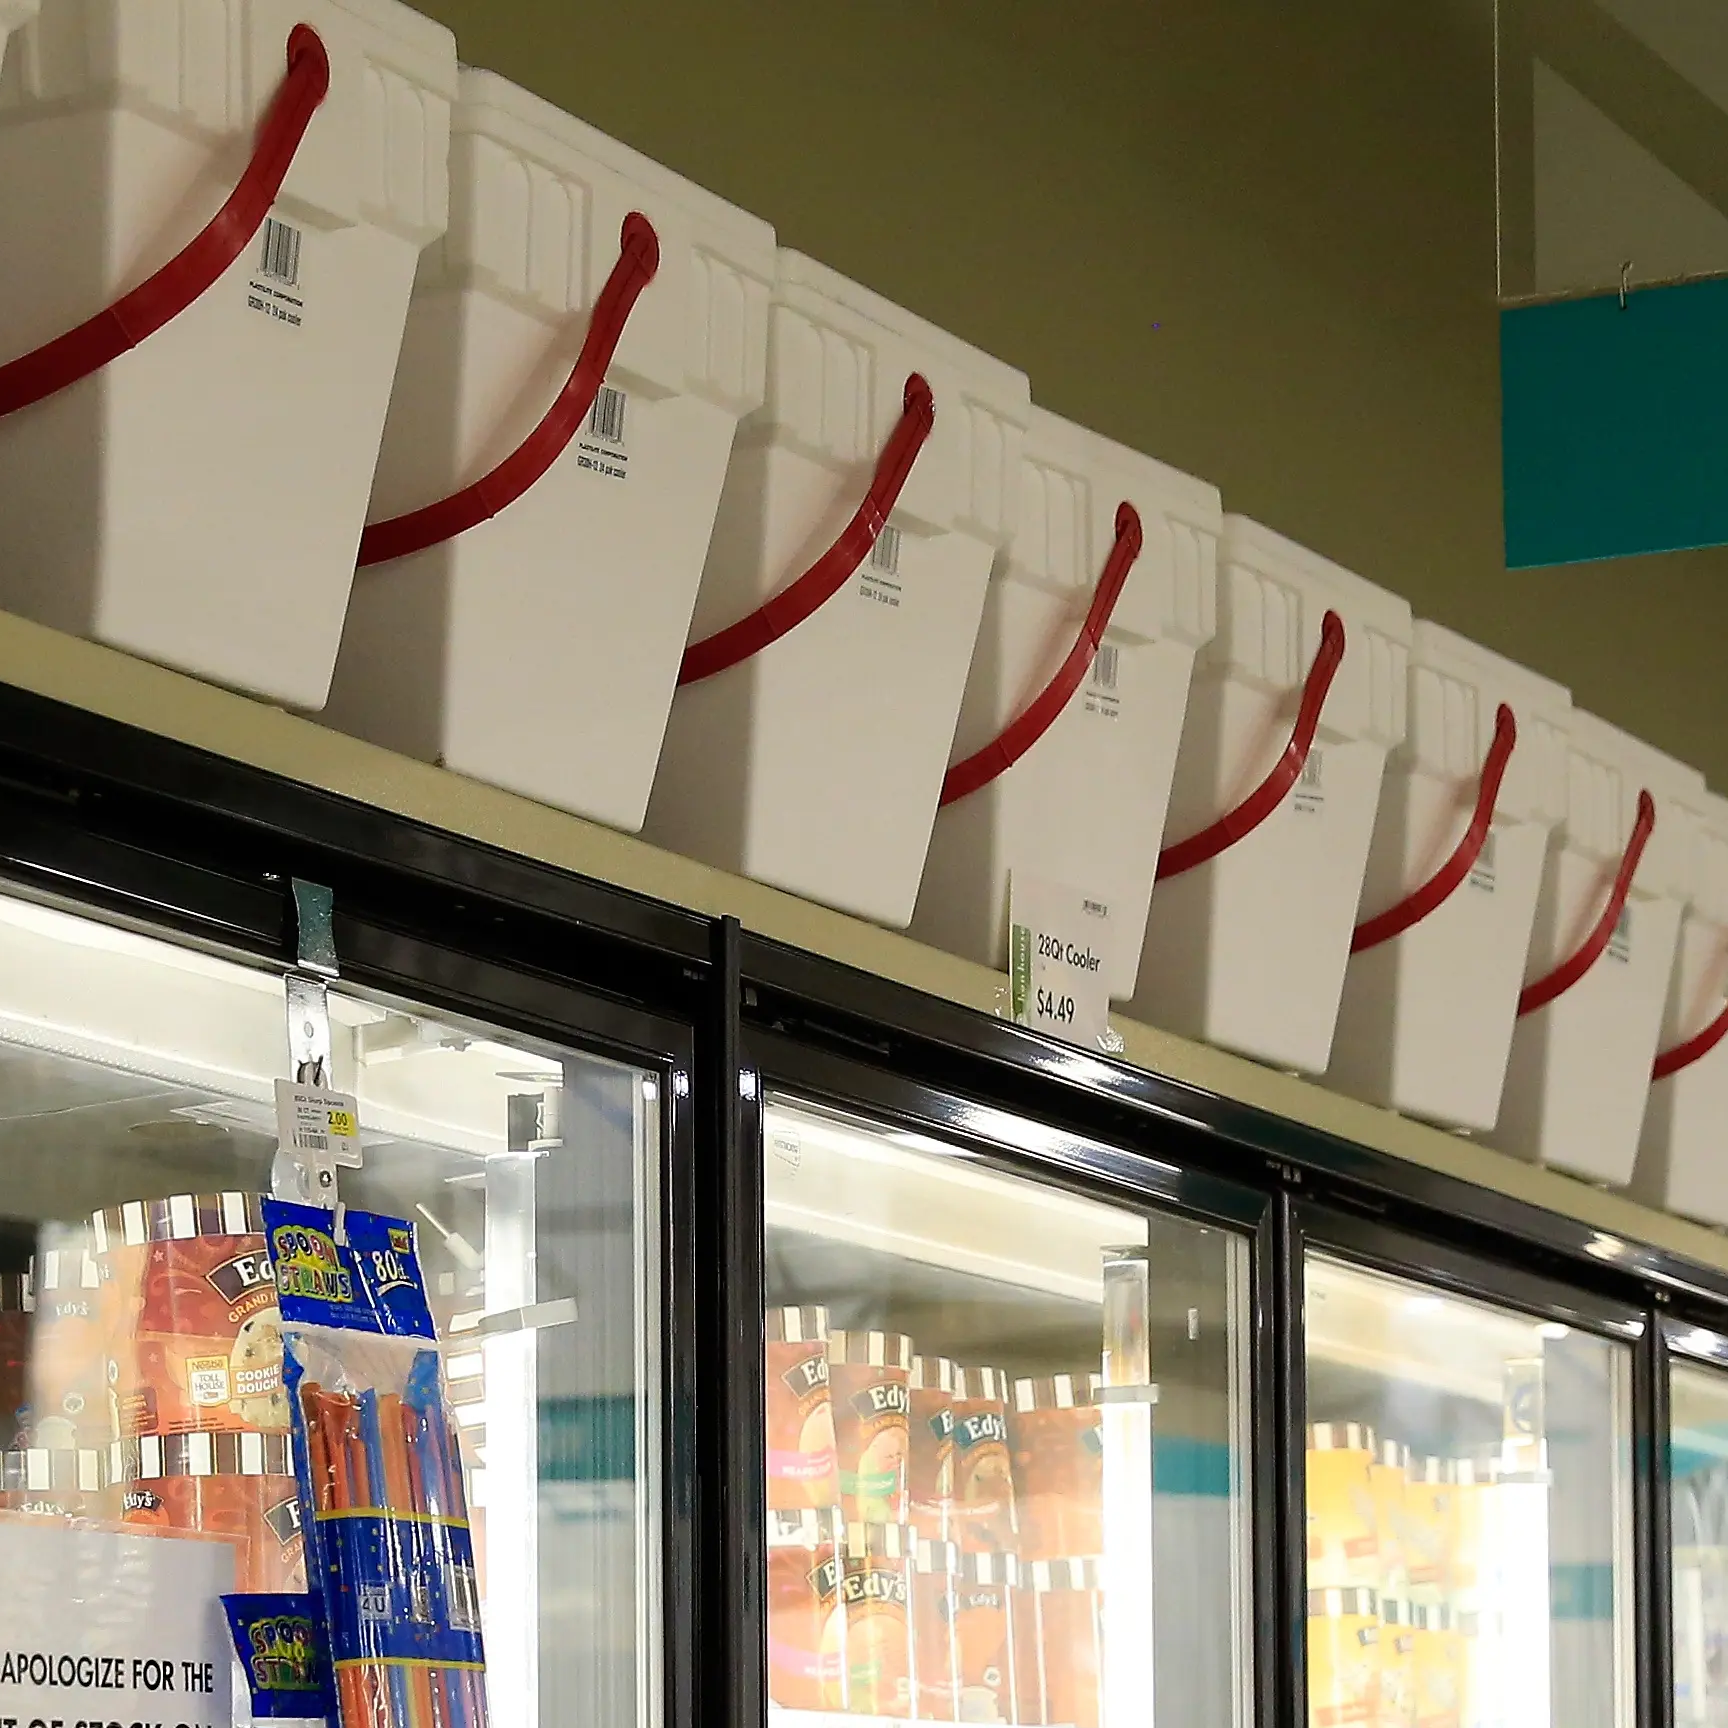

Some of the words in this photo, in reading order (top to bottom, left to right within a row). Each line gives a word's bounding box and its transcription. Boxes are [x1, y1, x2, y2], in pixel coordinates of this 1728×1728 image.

[1037, 933, 1064, 962] 28Qt
[1065, 943, 1101, 973] Cooler
[1037, 985, 1075, 1024] $4.49
[228, 1293, 268, 1324] GRAND
[235, 1363, 280, 1382] COOKIE
[236, 1376, 279, 1395] DOUGH
[280, 1543, 303, 1564] GRA
[844, 1572, 907, 1601] Edy's
[0, 1652, 125, 1689] APOLOGIZE
[132, 1659, 175, 1691] FOR
[182, 1661, 214, 1693] THE
